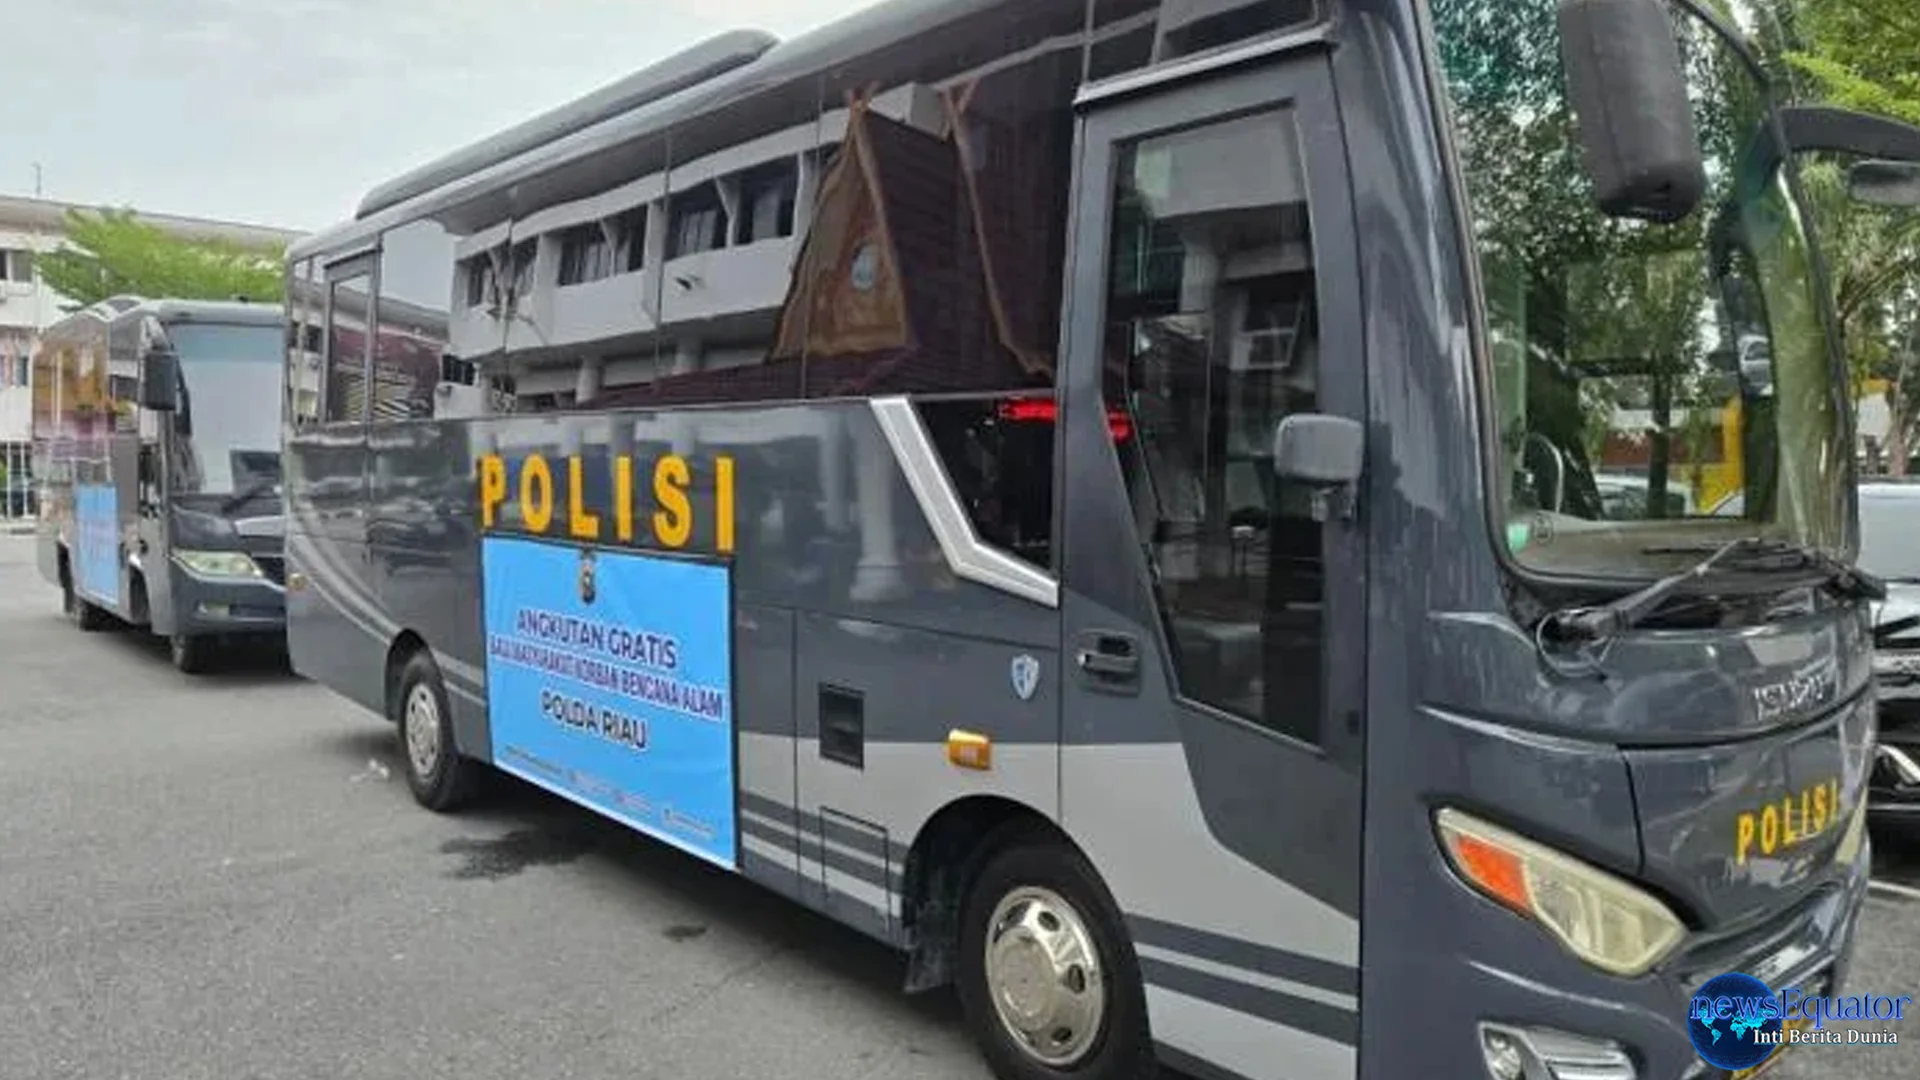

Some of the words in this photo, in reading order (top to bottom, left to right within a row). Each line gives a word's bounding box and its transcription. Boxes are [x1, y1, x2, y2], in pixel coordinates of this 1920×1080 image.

[480, 453, 734, 551] POLISI
[518, 609, 605, 651] ANGKUTAN
[608, 628, 677, 669] GRATIS
[542, 690, 598, 731] POLDA
[602, 708, 647, 748] RIAU
[1736, 777, 1837, 866] POLISI
